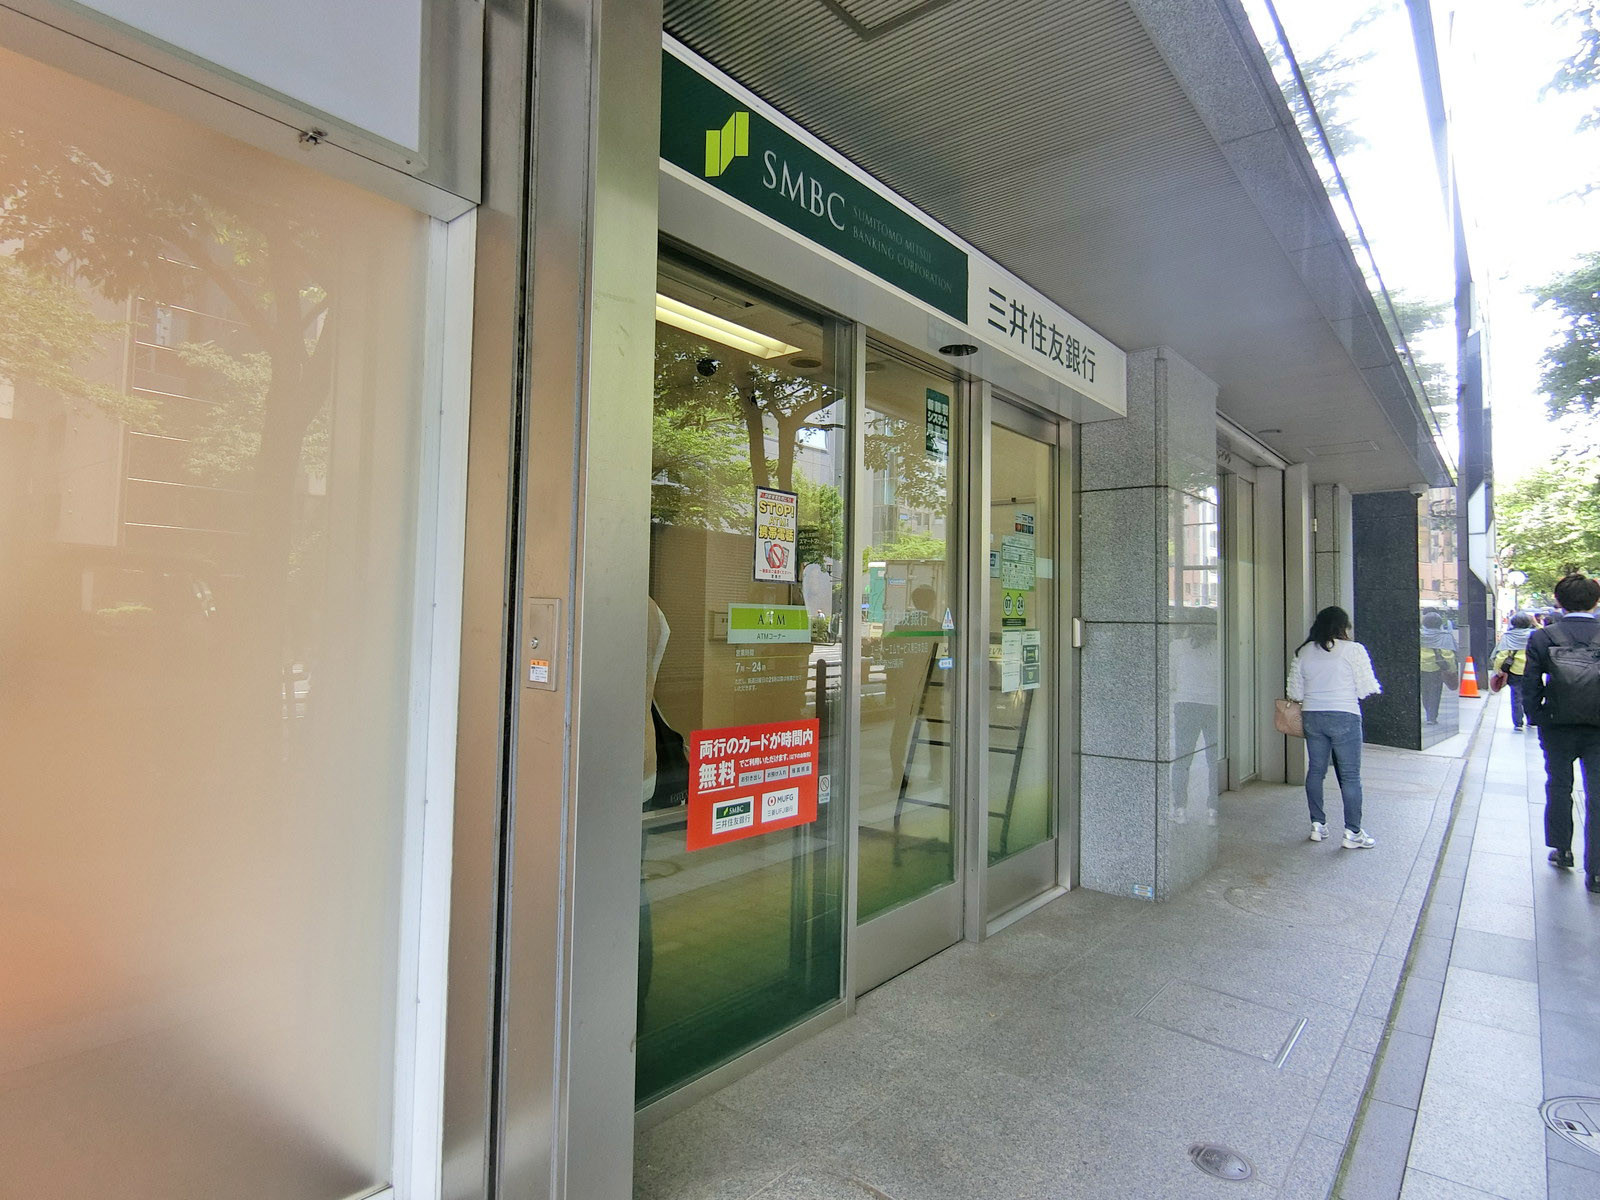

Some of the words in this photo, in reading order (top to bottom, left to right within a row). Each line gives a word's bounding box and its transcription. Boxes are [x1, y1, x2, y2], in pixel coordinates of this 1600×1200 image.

[762, 149, 846, 232] SMBC
[853, 206, 902, 247] SUMITOMO
[904, 238, 932, 264] MITSUI
[852, 226, 895, 262] BANKING
[897, 253, 952, 294] CORPORATION
[987, 285, 1097, 384] 三井住友銀行
[758, 500, 795, 518] STOP!
[758, 524, 794, 543] 携帯電話
[1017, 599, 1024, 609] 24
[757, 612, 786, 625] ATM
[756, 632, 787, 640] ATMコーナー
[699, 728, 814, 760] 両行のカードが時間内
[698, 759, 736, 789] 無料
[740, 774, 762, 783] お引き出し
[776, 793, 794, 804] MUFG
[728, 805, 745, 814] SMBC
[715, 814, 751, 830] 三井住友銀行
